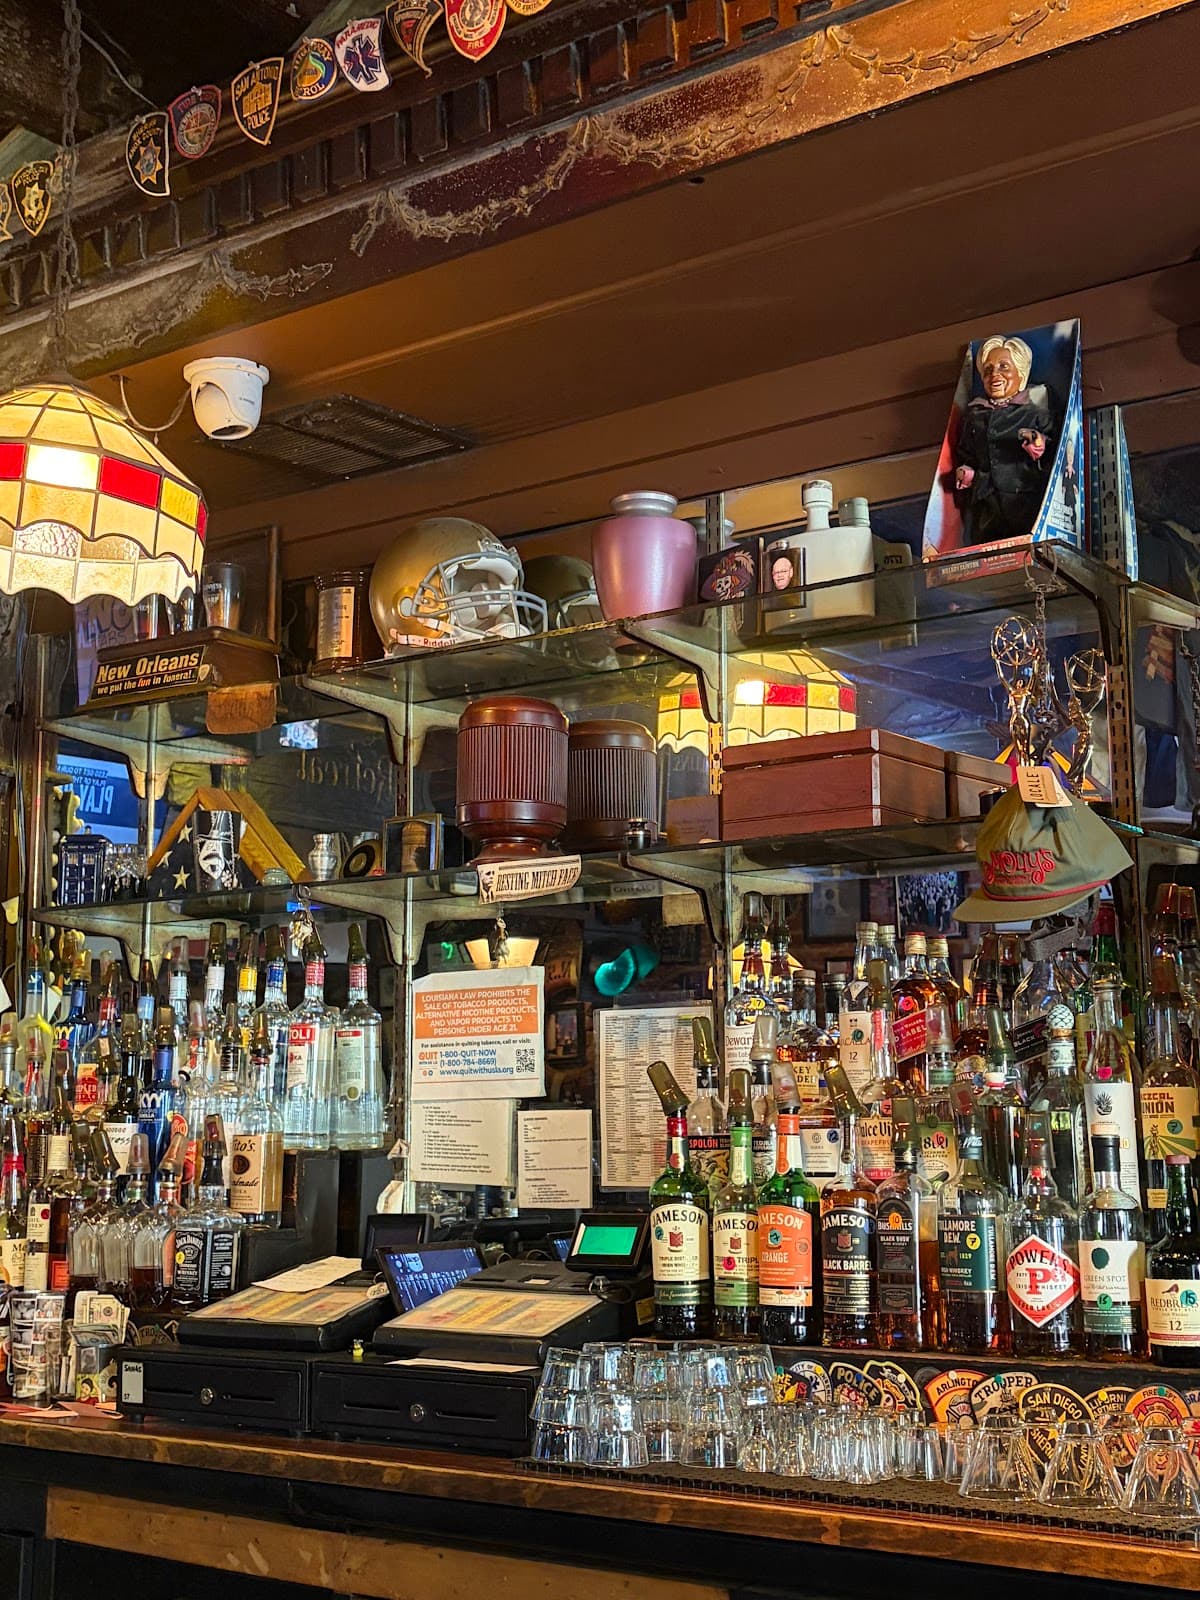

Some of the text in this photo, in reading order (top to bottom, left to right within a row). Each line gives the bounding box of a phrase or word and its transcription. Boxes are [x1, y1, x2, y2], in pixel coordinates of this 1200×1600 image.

[337, 21, 379, 48] PARAMEDIC
[467, 39, 485, 49] FIRE
[235, 77, 250, 100] SAN
[246, 107, 271, 129] POLICE
[97, 653, 200, 683] New Orleans
[97, 686, 109, 695] we
[109, 683, 122, 695] put
[124, 681, 137, 689] the
[138, 678, 151, 688] fun
[152, 676, 161, 685] in
[1026, 772, 1044, 801] LOCALE
[496, 867, 578, 891] RESTING MITCH FACE
[422, 988, 531, 1002] LOUISIANA LAW PROHIBITS THE
[424, 1003, 440, 1011] SALE
[453, 1000, 486, 1008] TOBACCO
[416, 1010, 460, 1020] ALTERNATIVE
[462, 1008, 495, 1016] NICOTINE
[429, 1019, 445, 1027] AND
[446, 1017, 471, 1025] VAPOR
[471, 1015, 511, 1024] PRODUCTS
[467, 1025, 491, 1033] UNDER
[493, 1024, 507, 1032] AGE
[902, 1024, 928, 1039] LABEL
[418, 1049, 497, 1061] QUIT 1-800-QUIT-NOW
[849, 1052, 859, 1061] 12
[653, 1209, 704, 1227] JAMESON
[822, 1214, 865, 1231] JAMESO
[176, 1237, 188, 1249] JACK
[762, 1252, 789, 1263] ORANGE
[843, 1260, 872, 1271] BARREL
[1106, 1274, 1127, 1283] SPOT
[1169, 1320, 1182, 1331] 12
[837, 1367, 879, 1401] POLICE
[975, 1376, 1033, 1401] TROOPER
[1142, 1388, 1157, 1398] FIRE
[1027, 1392, 1083, 1420] SAN DIEGO
